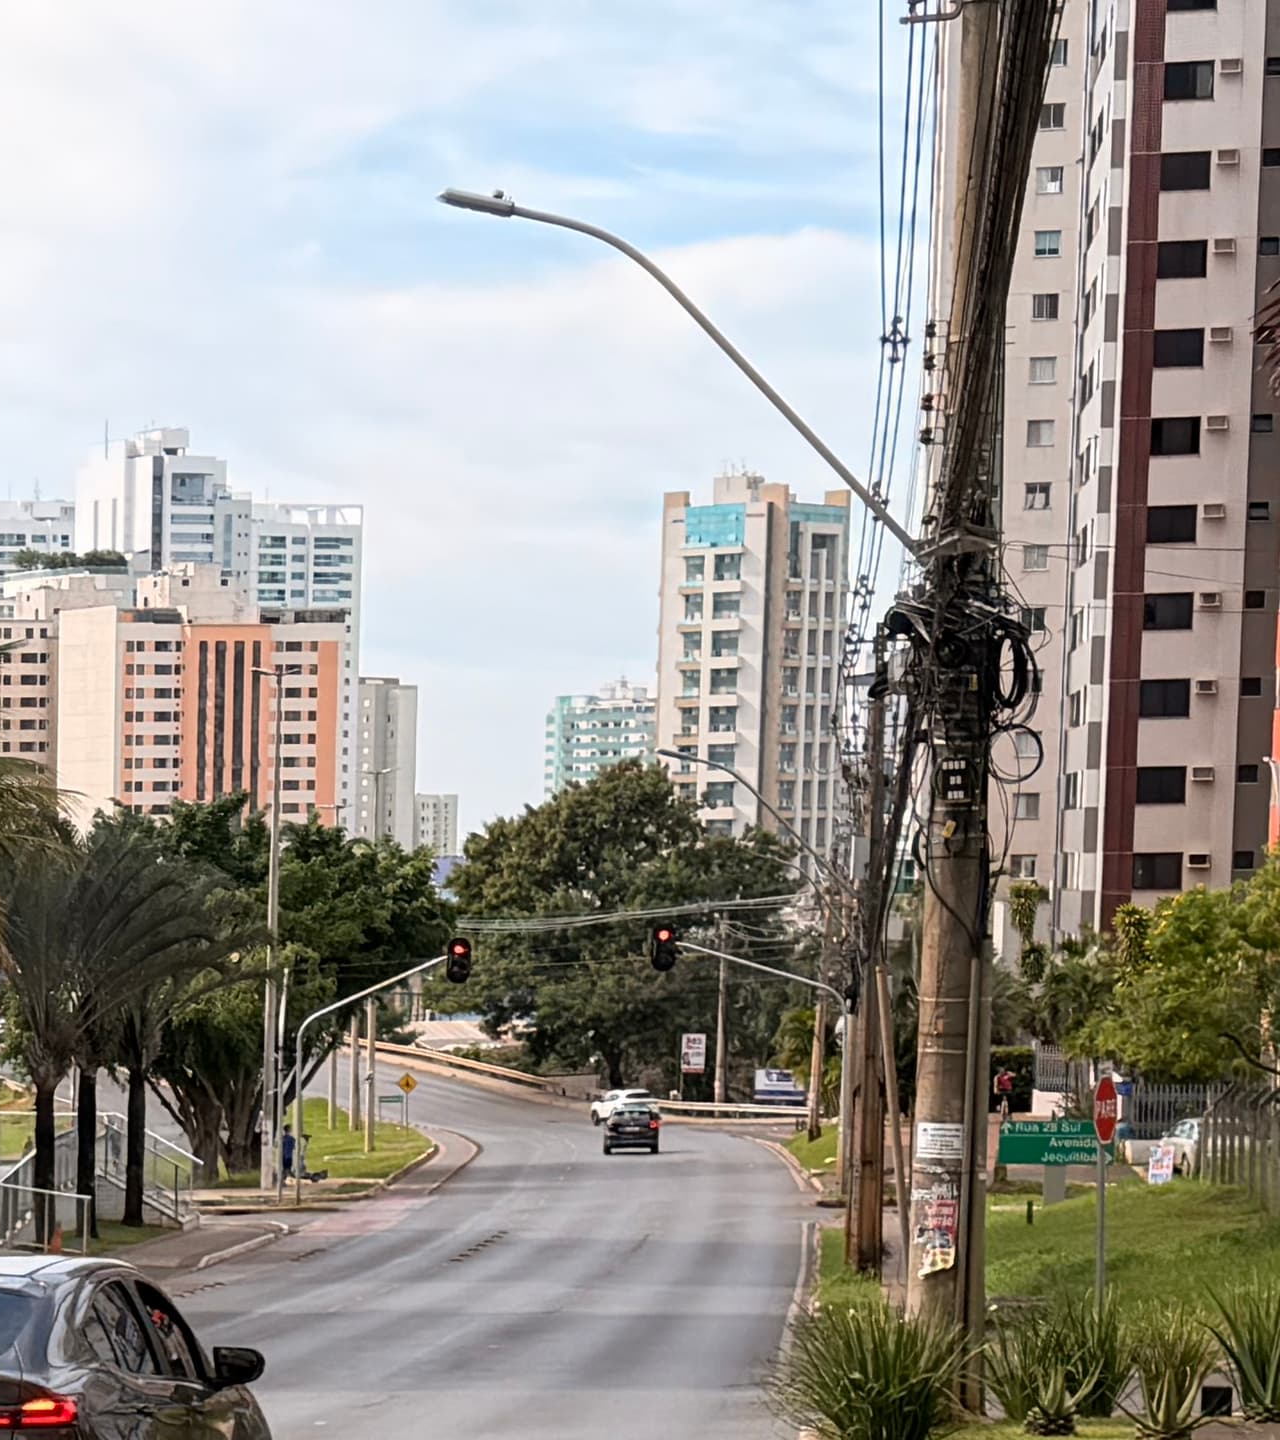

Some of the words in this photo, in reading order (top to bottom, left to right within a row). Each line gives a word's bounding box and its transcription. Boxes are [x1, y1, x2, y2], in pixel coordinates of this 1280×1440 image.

[1095, 1099, 1116, 1118] PARE
[1015, 1122, 1040, 1133] Rua
[1060, 1121, 1081, 1133] Sul
[1049, 1137, 1099, 1149] Avenida
